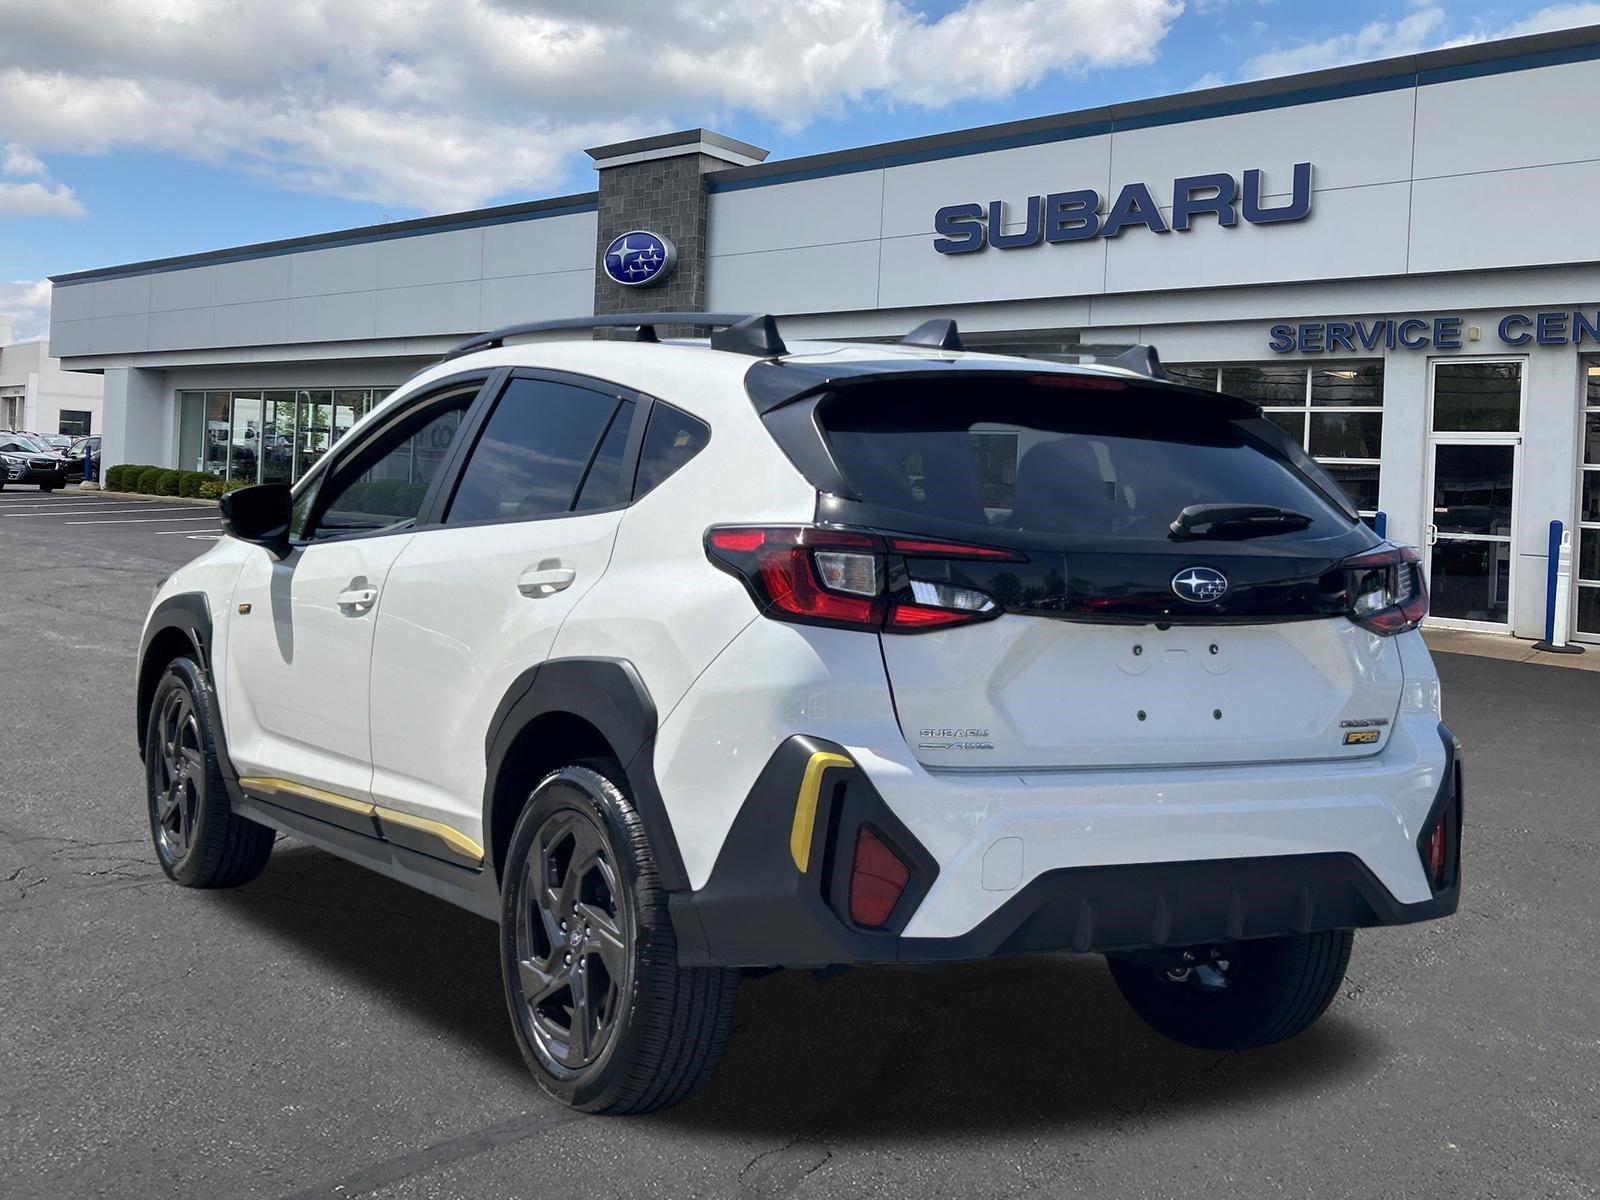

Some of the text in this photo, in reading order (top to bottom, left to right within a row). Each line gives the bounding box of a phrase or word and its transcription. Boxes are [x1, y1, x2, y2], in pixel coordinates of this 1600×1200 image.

[933, 161, 1314, 255] SUBARU
[1268, 317, 1464, 353] SERVICE
[919, 728, 990, 738] SUBARU
